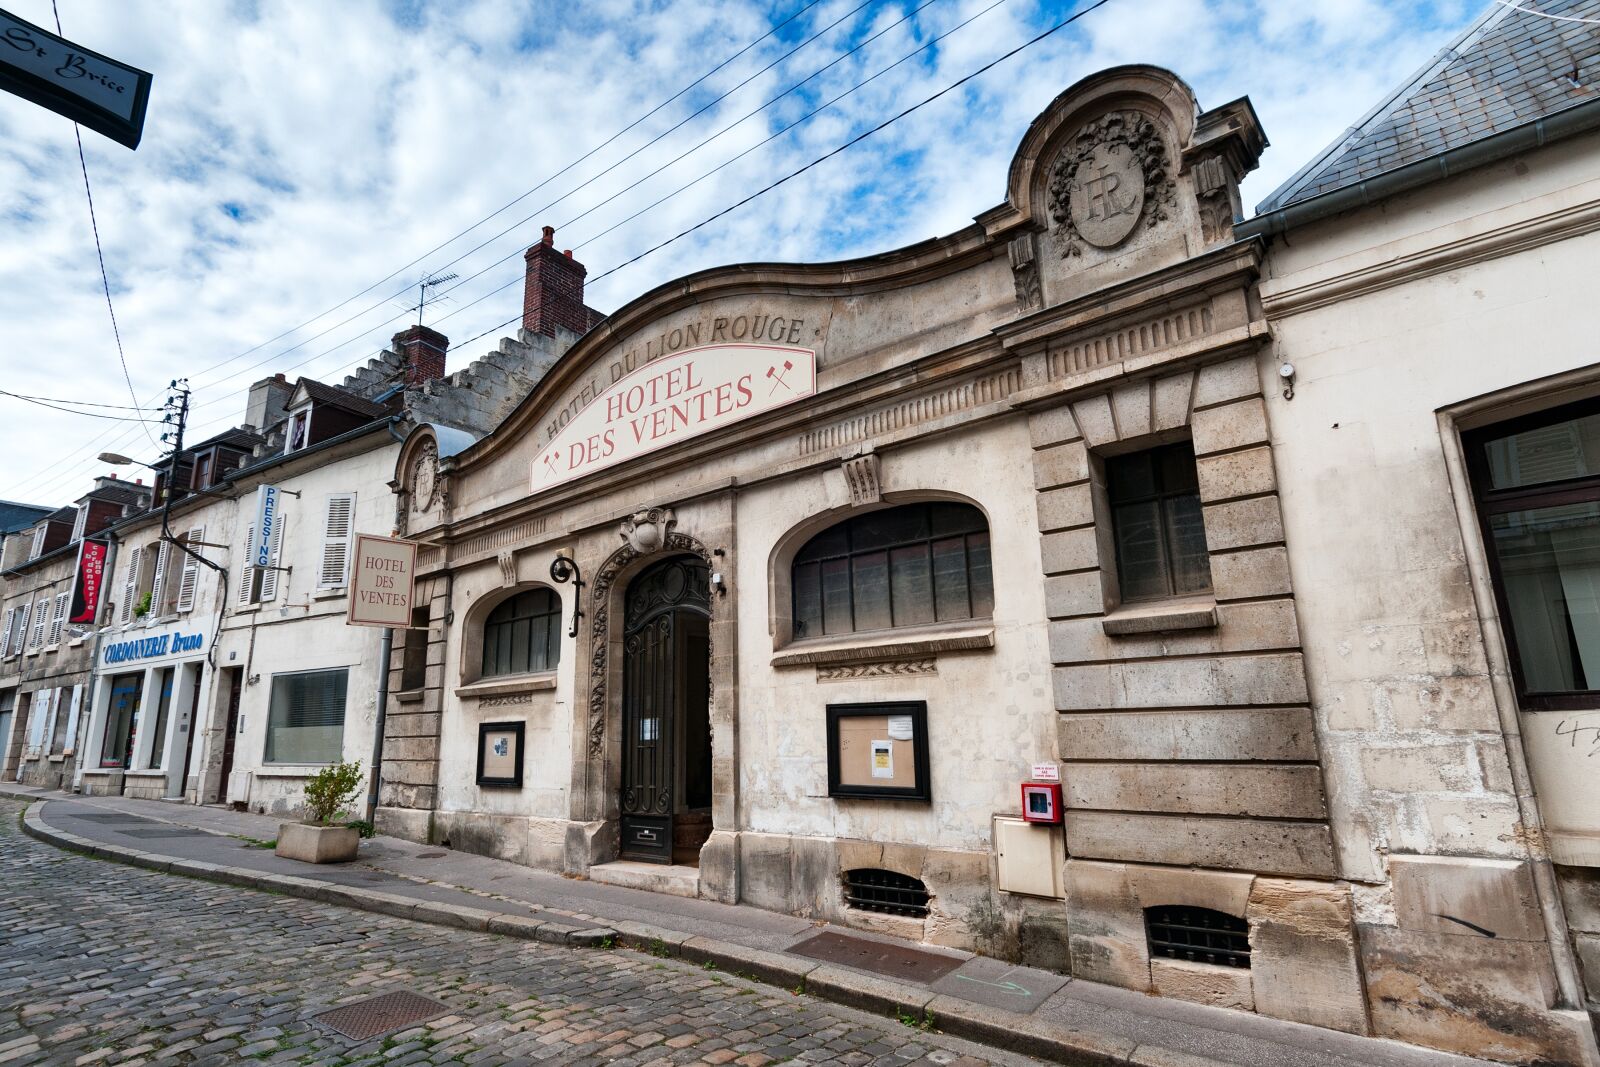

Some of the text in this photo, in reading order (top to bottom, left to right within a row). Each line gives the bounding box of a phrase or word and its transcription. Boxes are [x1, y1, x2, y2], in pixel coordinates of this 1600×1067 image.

[0, 27, 126, 93] St Brice
[546, 315, 804, 440] HOTEL DU LION ROUGE
[605, 361, 703, 424] HOTEL
[568, 374, 753, 470] DES VENTES
[258, 487, 275, 566] PRESSING
[365, 556, 406, 573] HOTEL
[375, 575, 394, 589] DES
[360, 590, 407, 607] VENTES
[104, 632, 203, 665] CORDONNERIE Bruno
